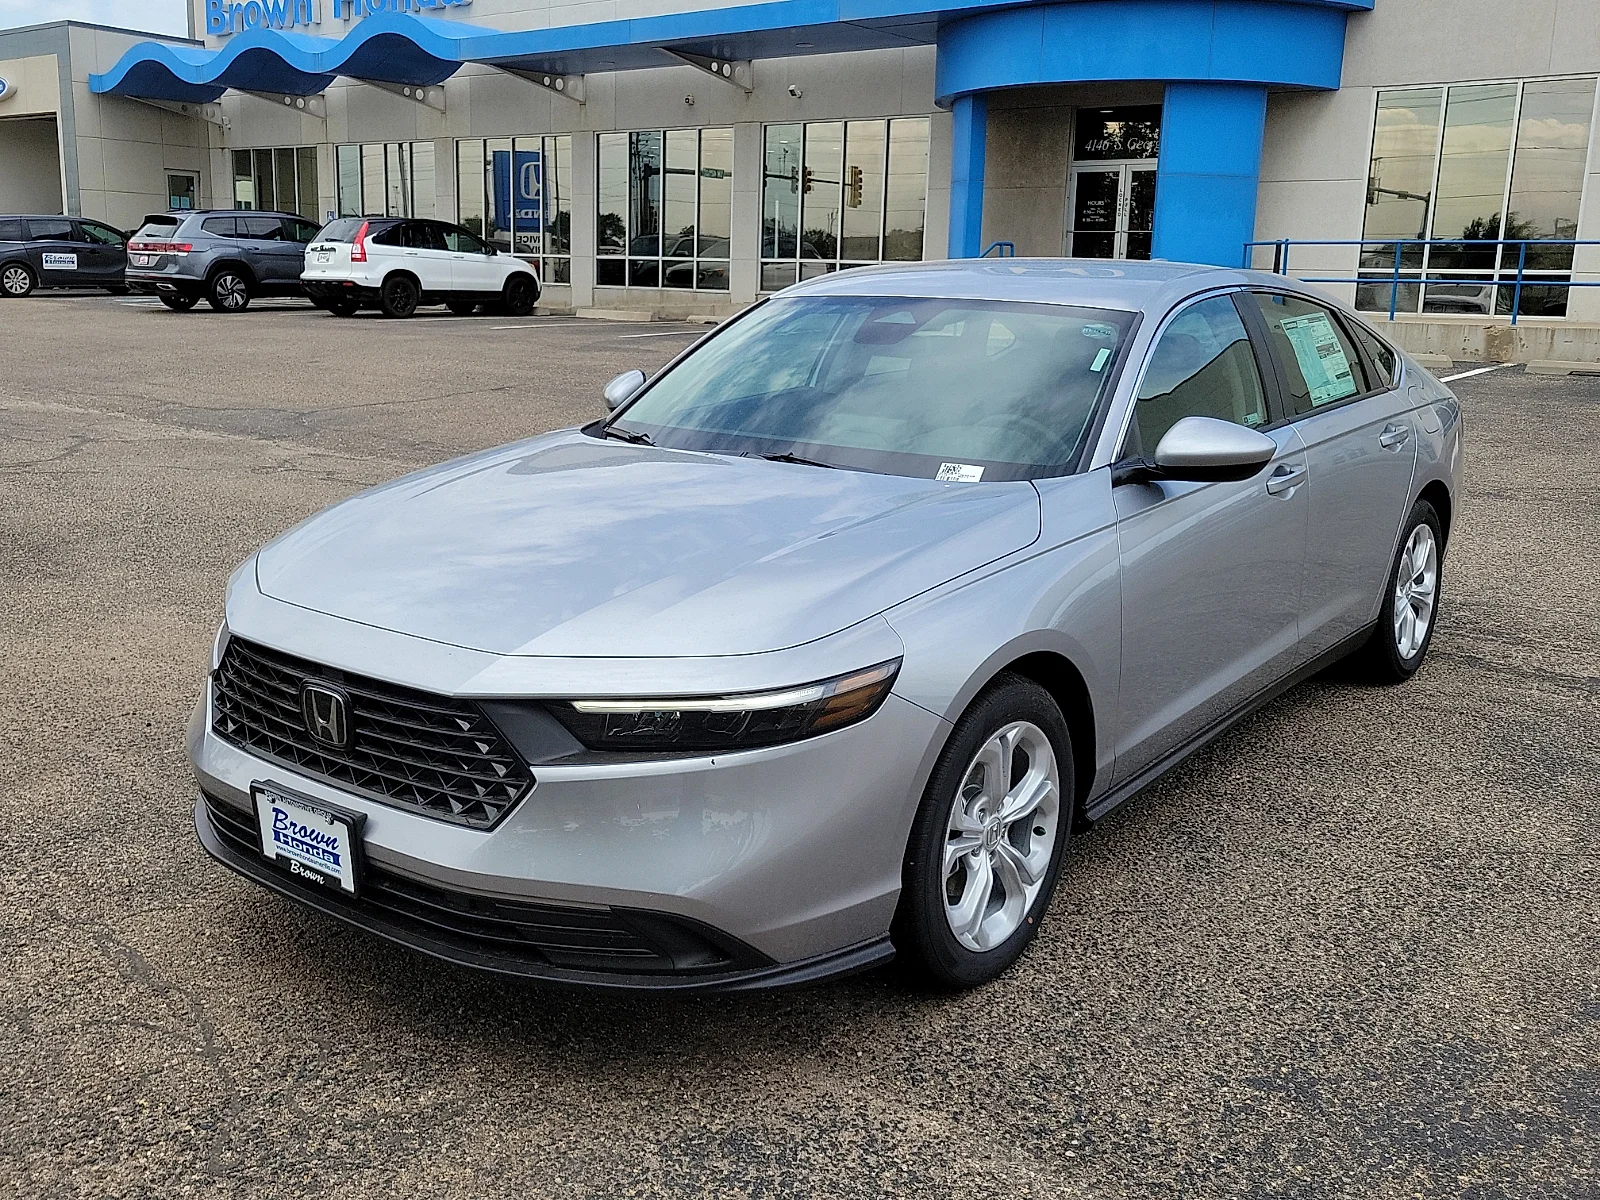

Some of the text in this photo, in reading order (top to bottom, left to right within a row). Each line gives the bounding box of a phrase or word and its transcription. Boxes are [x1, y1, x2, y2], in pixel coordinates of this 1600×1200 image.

[205, 0, 315, 35] Brown
[271, 806, 340, 851] Brown
[279, 832, 334, 864] Honda
[290, 859, 326, 885] Brown
